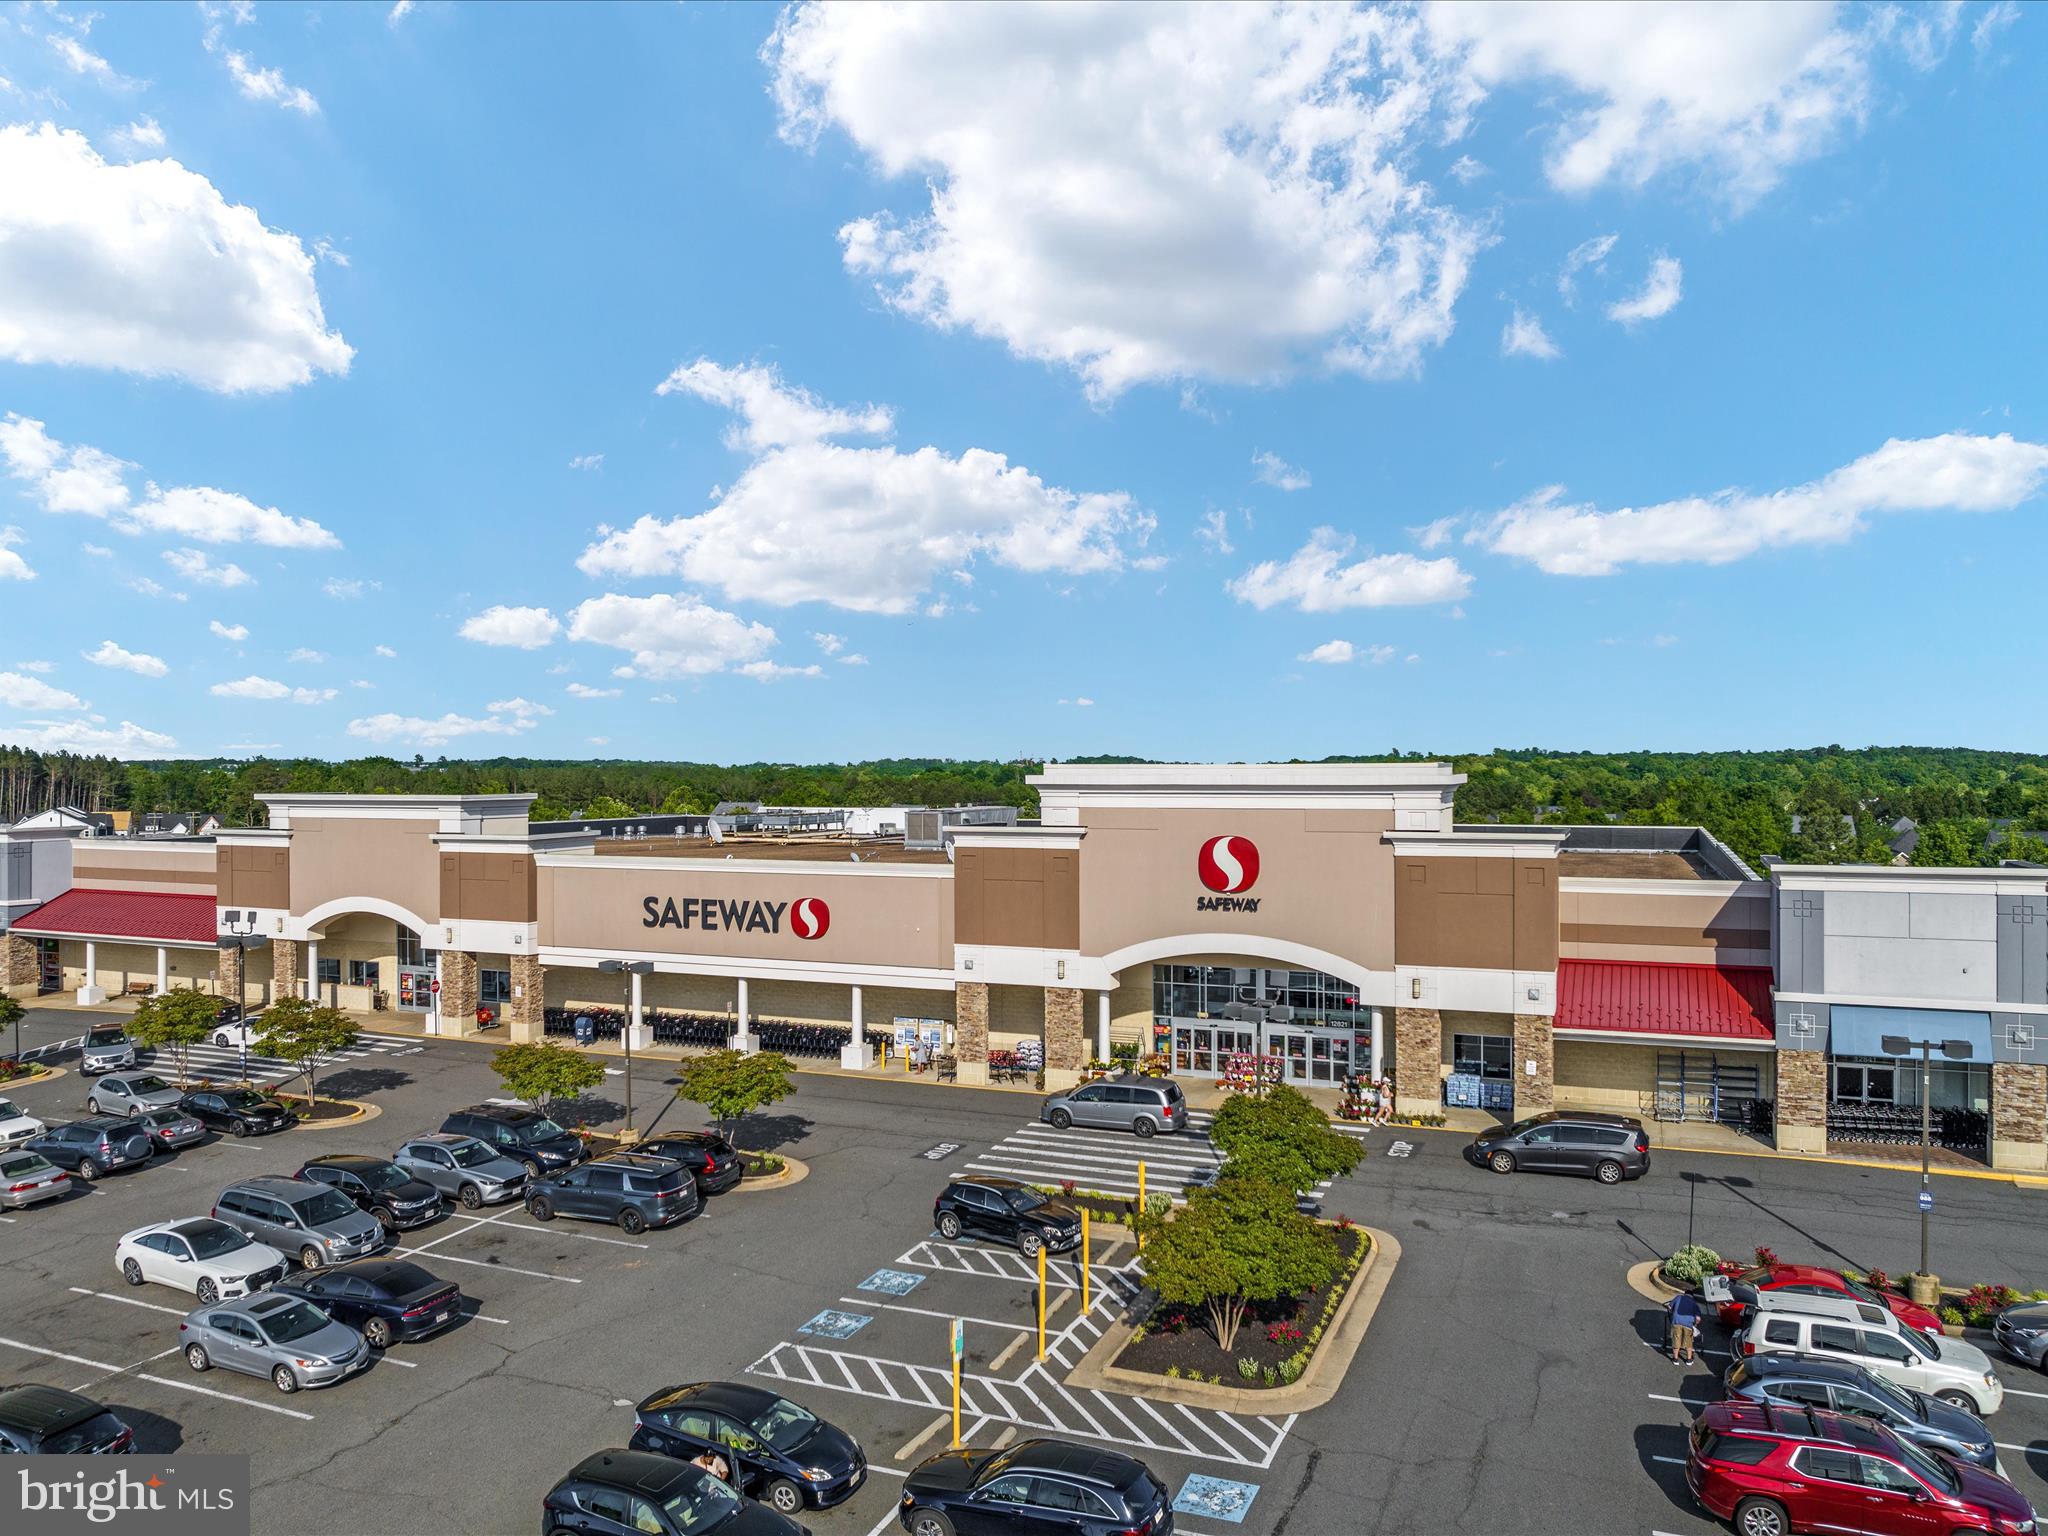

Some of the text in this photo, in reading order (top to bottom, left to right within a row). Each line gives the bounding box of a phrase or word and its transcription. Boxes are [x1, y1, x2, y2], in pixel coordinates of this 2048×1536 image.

[1196, 896, 1262, 913] SAFEWAY
[642, 896, 788, 934] SAFEWAY
[1387, 1141, 1413, 1157] STOP
